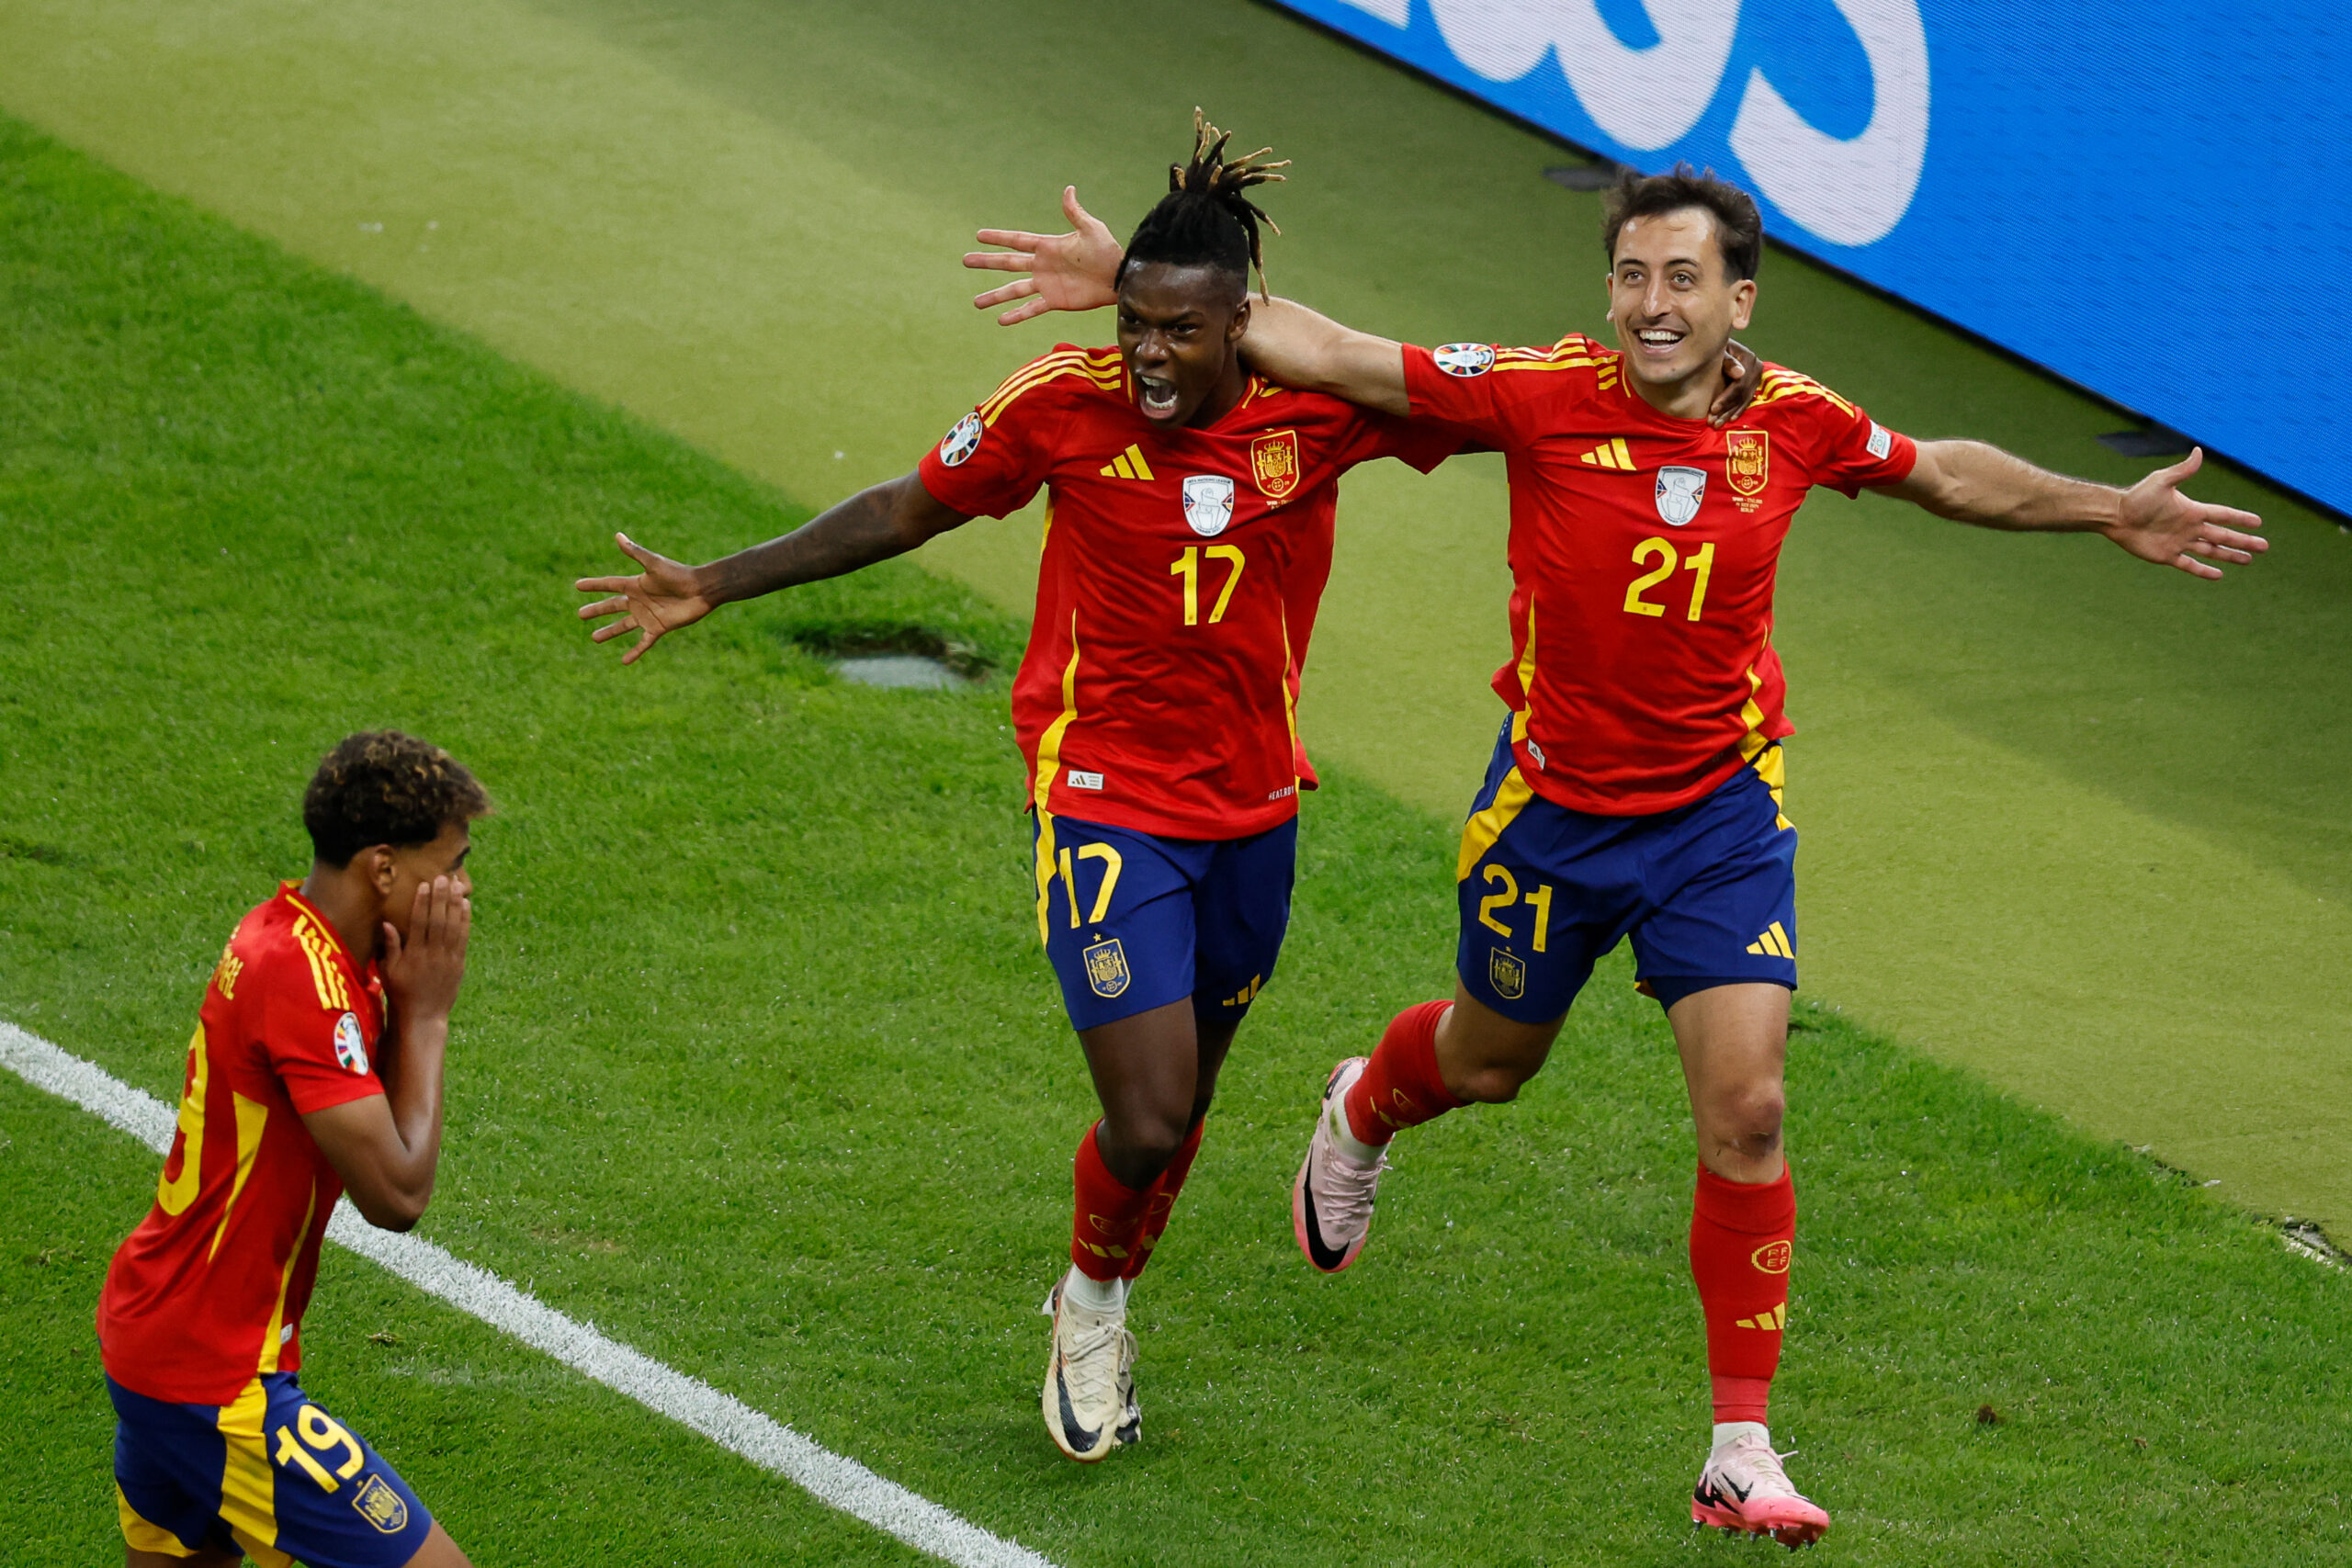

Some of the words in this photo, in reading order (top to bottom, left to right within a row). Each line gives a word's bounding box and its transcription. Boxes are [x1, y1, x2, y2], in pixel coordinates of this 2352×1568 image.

[1170, 545, 1246, 626] 17
[1623, 536, 1714, 622] 21
[1059, 841, 1123, 929] 17
[1478, 863, 1553, 953] 21
[276, 1404, 365, 1495] 19
